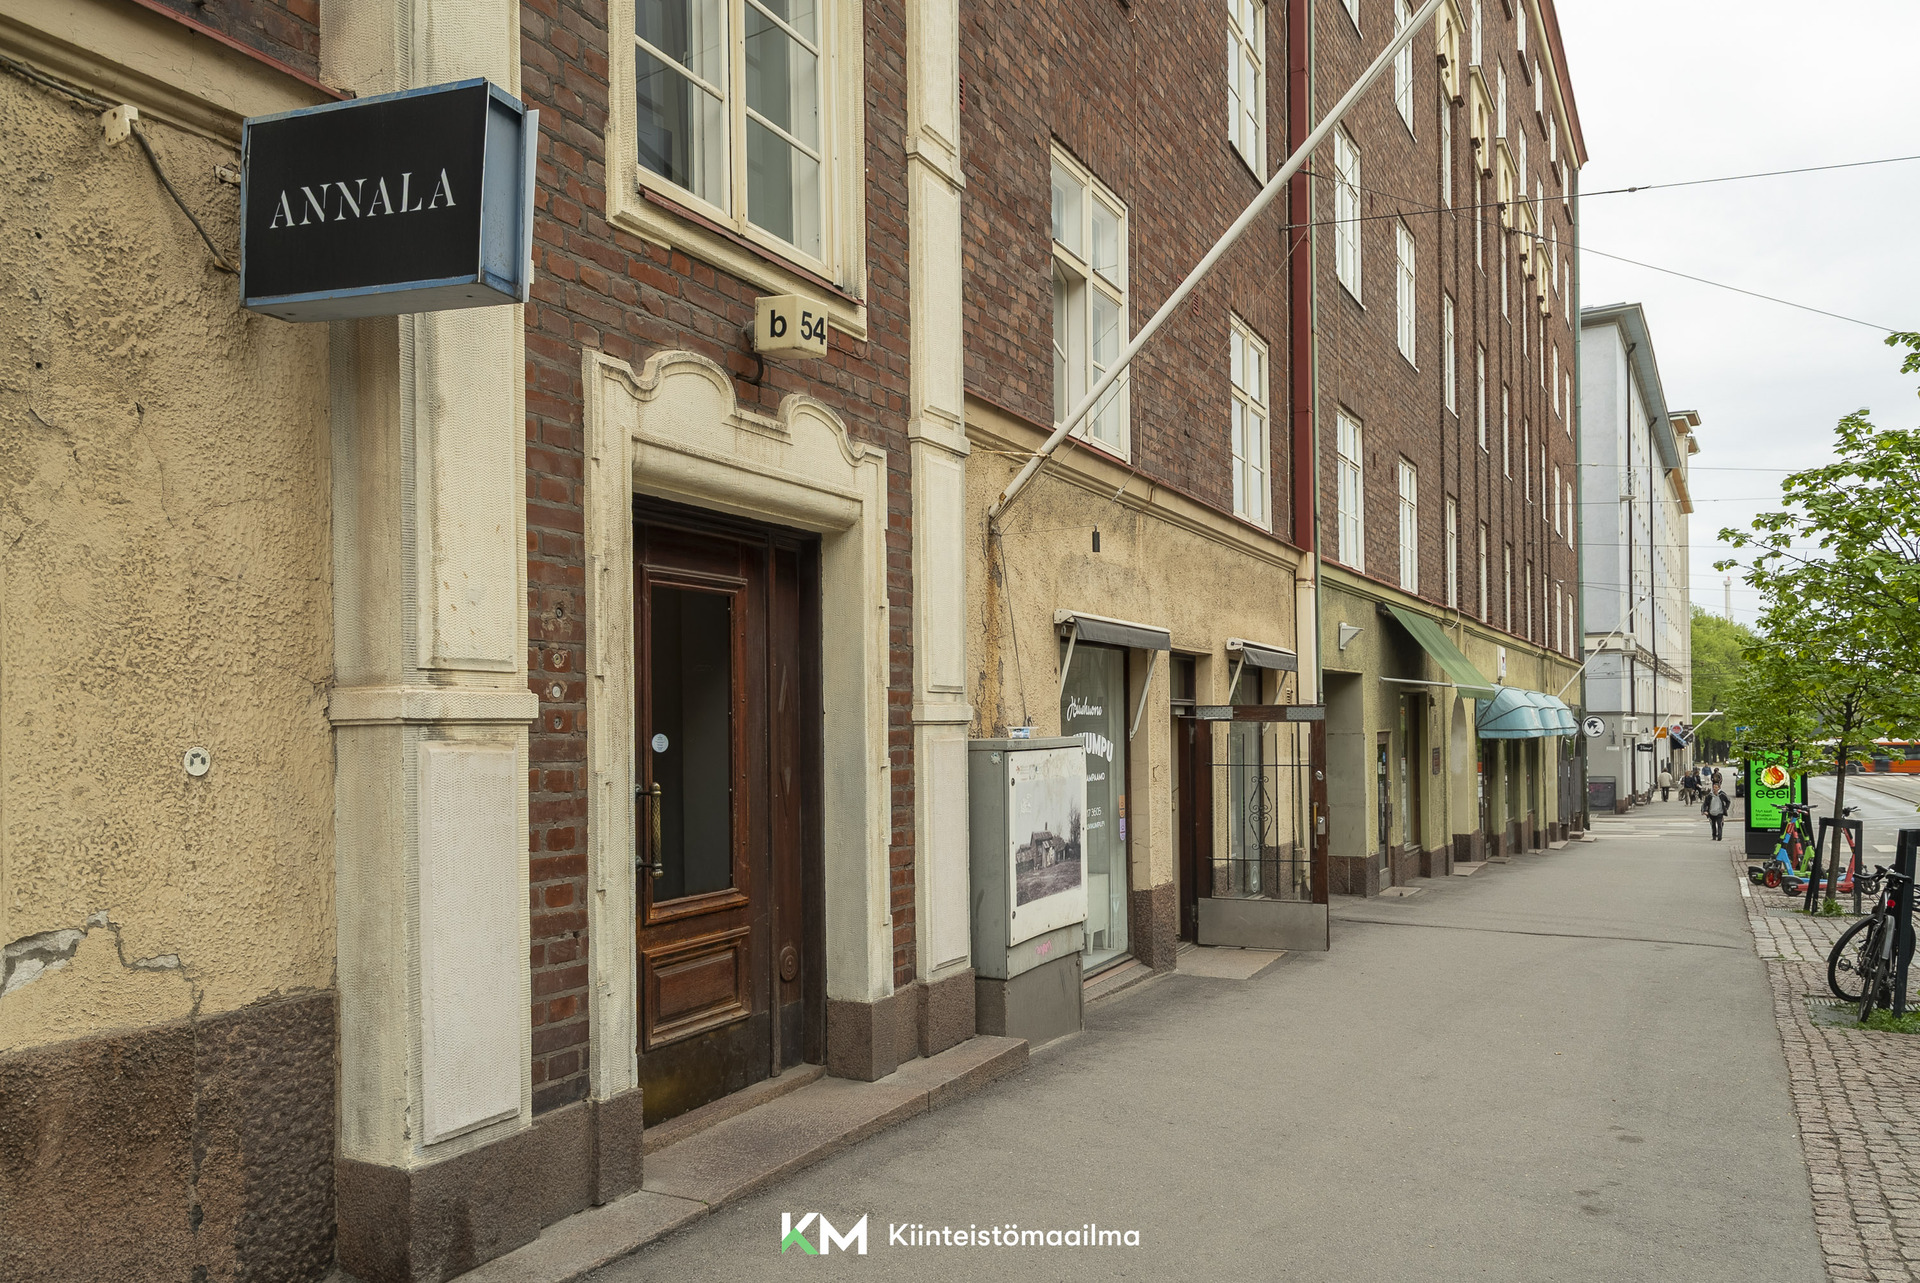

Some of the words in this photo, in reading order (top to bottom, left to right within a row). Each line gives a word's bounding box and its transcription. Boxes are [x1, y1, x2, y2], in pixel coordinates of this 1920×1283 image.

[269, 168, 457, 229] ANNALA
[770, 309, 787, 338] b
[800, 310, 826, 346] 54
